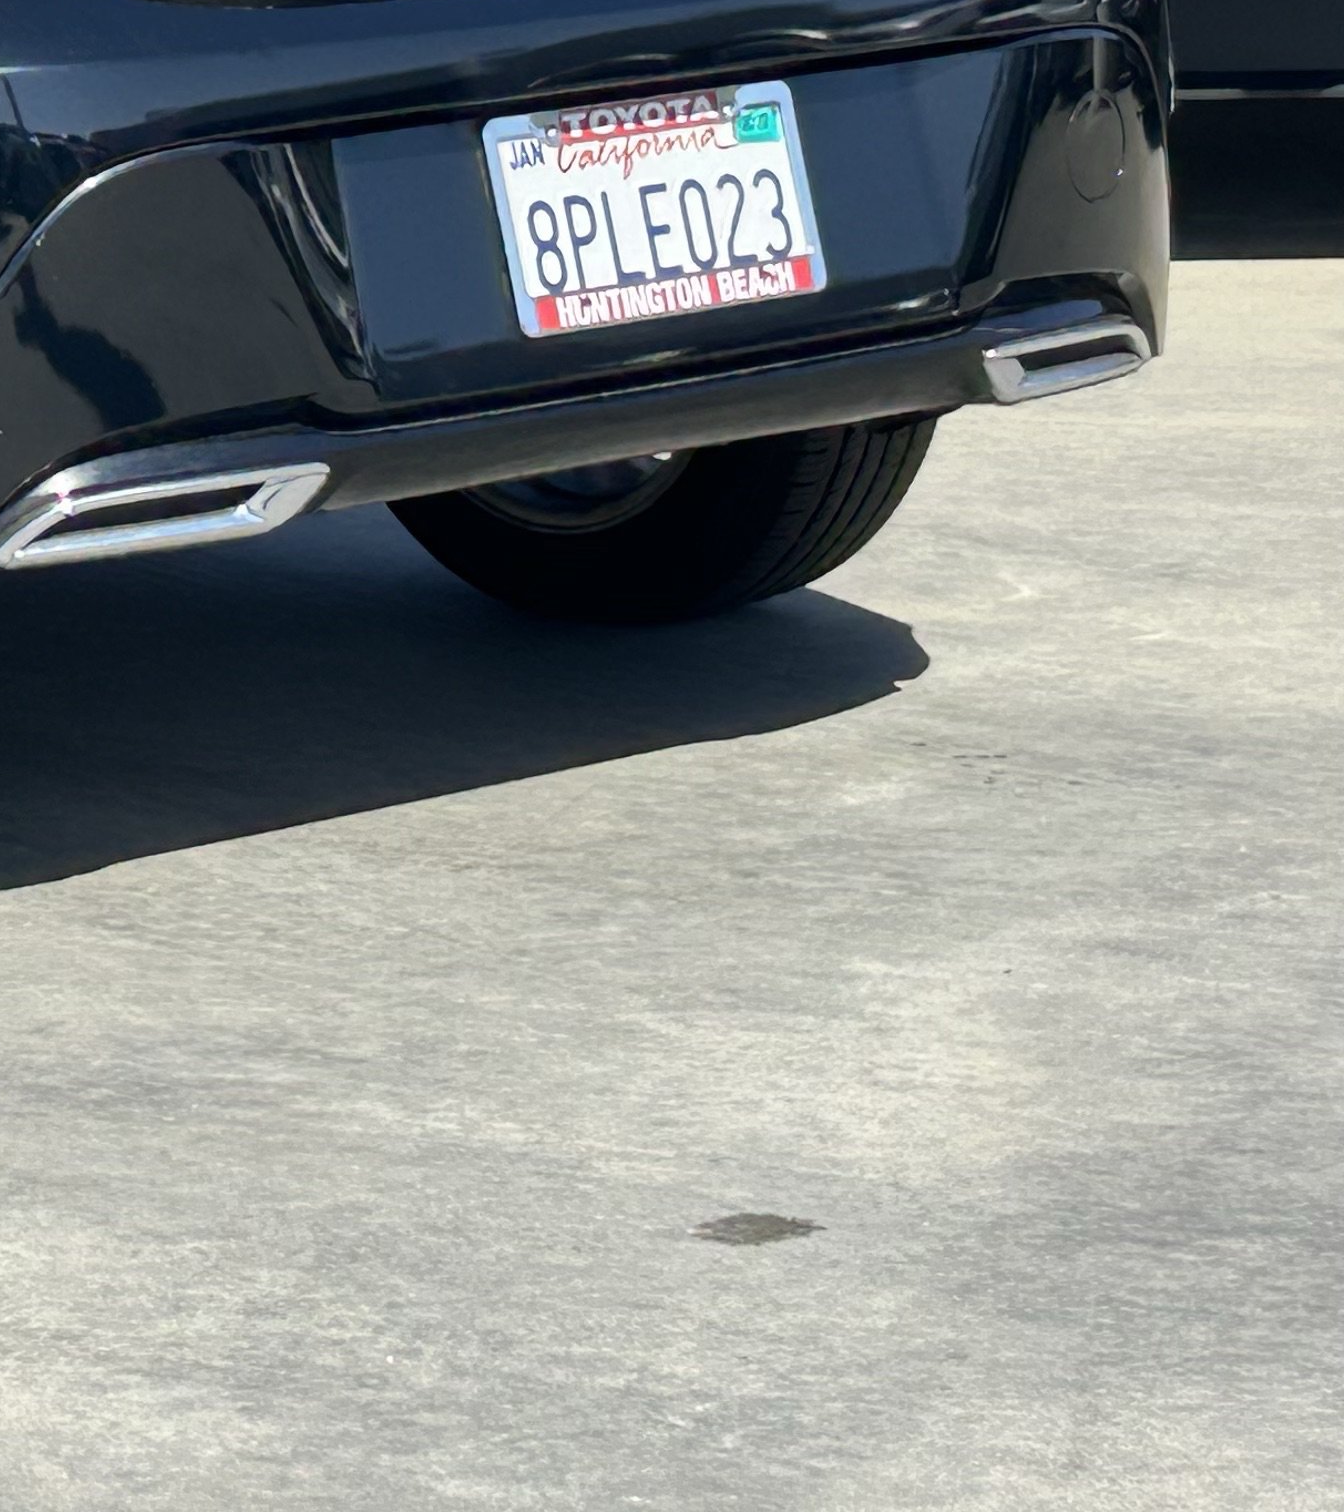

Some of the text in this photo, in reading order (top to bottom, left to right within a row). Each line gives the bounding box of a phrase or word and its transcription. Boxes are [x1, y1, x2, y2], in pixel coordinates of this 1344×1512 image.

[562, 95, 719, 137] TOYOTA
[510, 138, 545, 171] JAN
[557, 126, 737, 180] California
[527, 168, 793, 297] 8PLE023
[556, 261, 795, 328] HUNTINGTON BEACH
